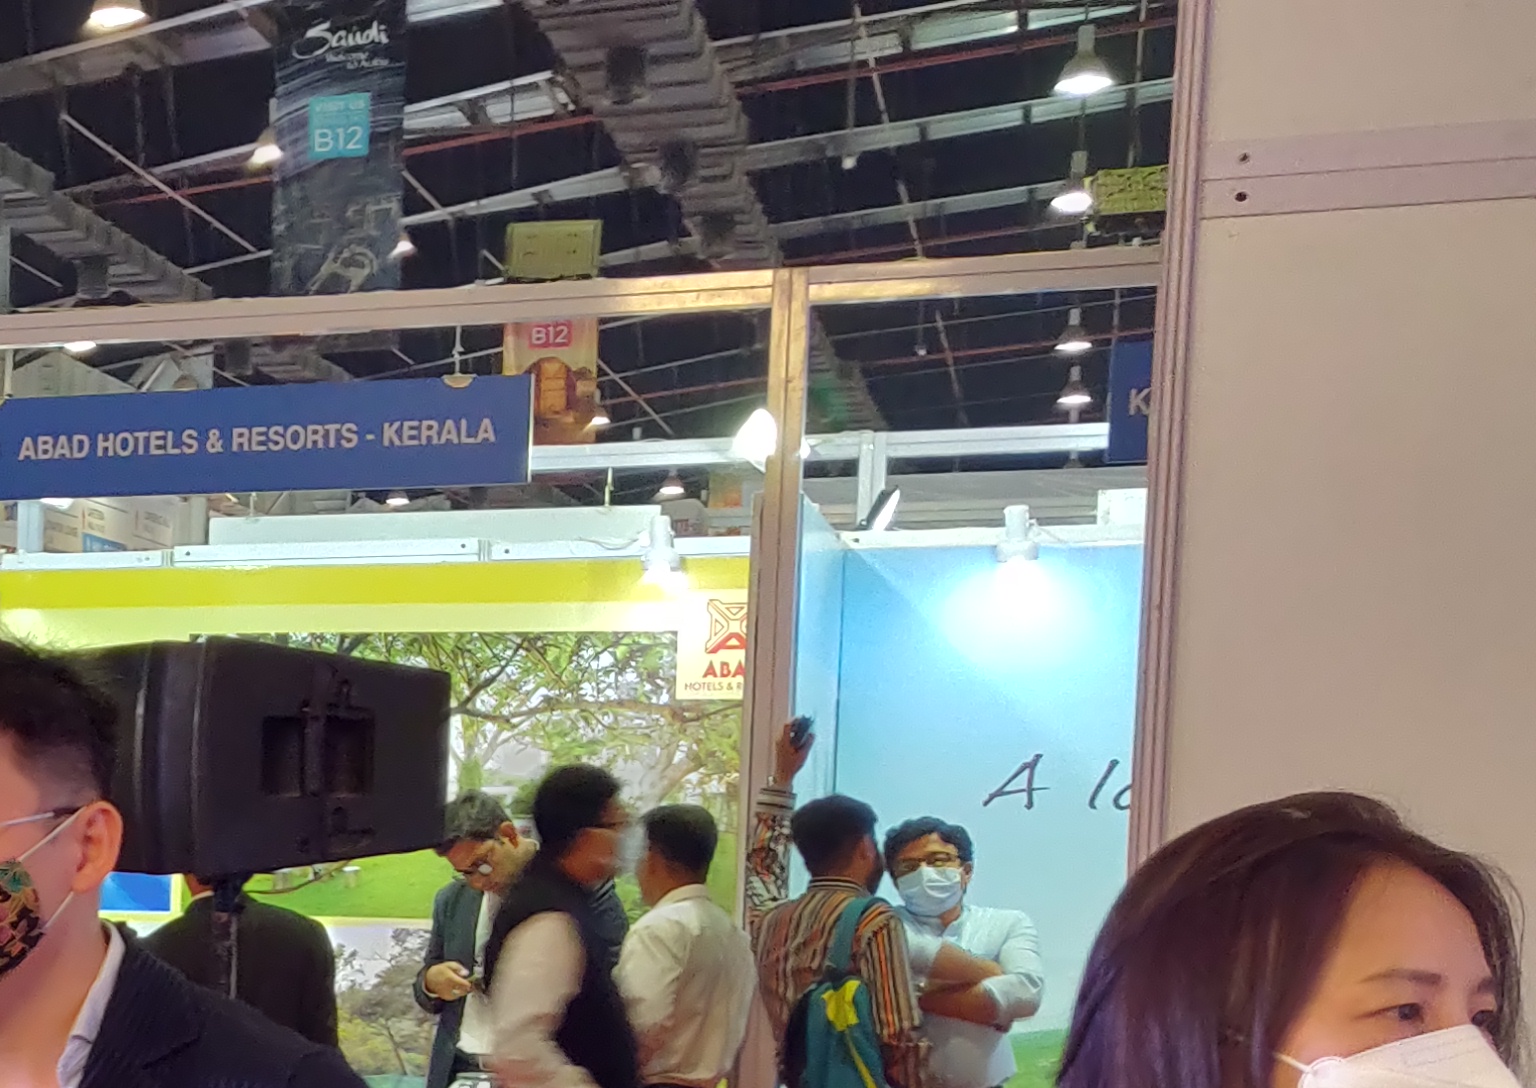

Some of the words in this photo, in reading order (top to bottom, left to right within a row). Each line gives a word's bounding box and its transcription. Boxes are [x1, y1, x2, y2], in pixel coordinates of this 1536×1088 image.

[292, 20, 389, 59] Saudi
[314, 126, 363, 151] B12
[531, 325, 568, 344] B12
[18, 434, 90, 461] ABAD
[97, 428, 198, 457] HOTELS
[205, 428, 224, 453] &
[232, 422, 358, 452] RESORTS
[383, 418, 496, 446] KERALA
[684, 682, 724, 691] HOTELS
[982, 753, 1050, 811] A
